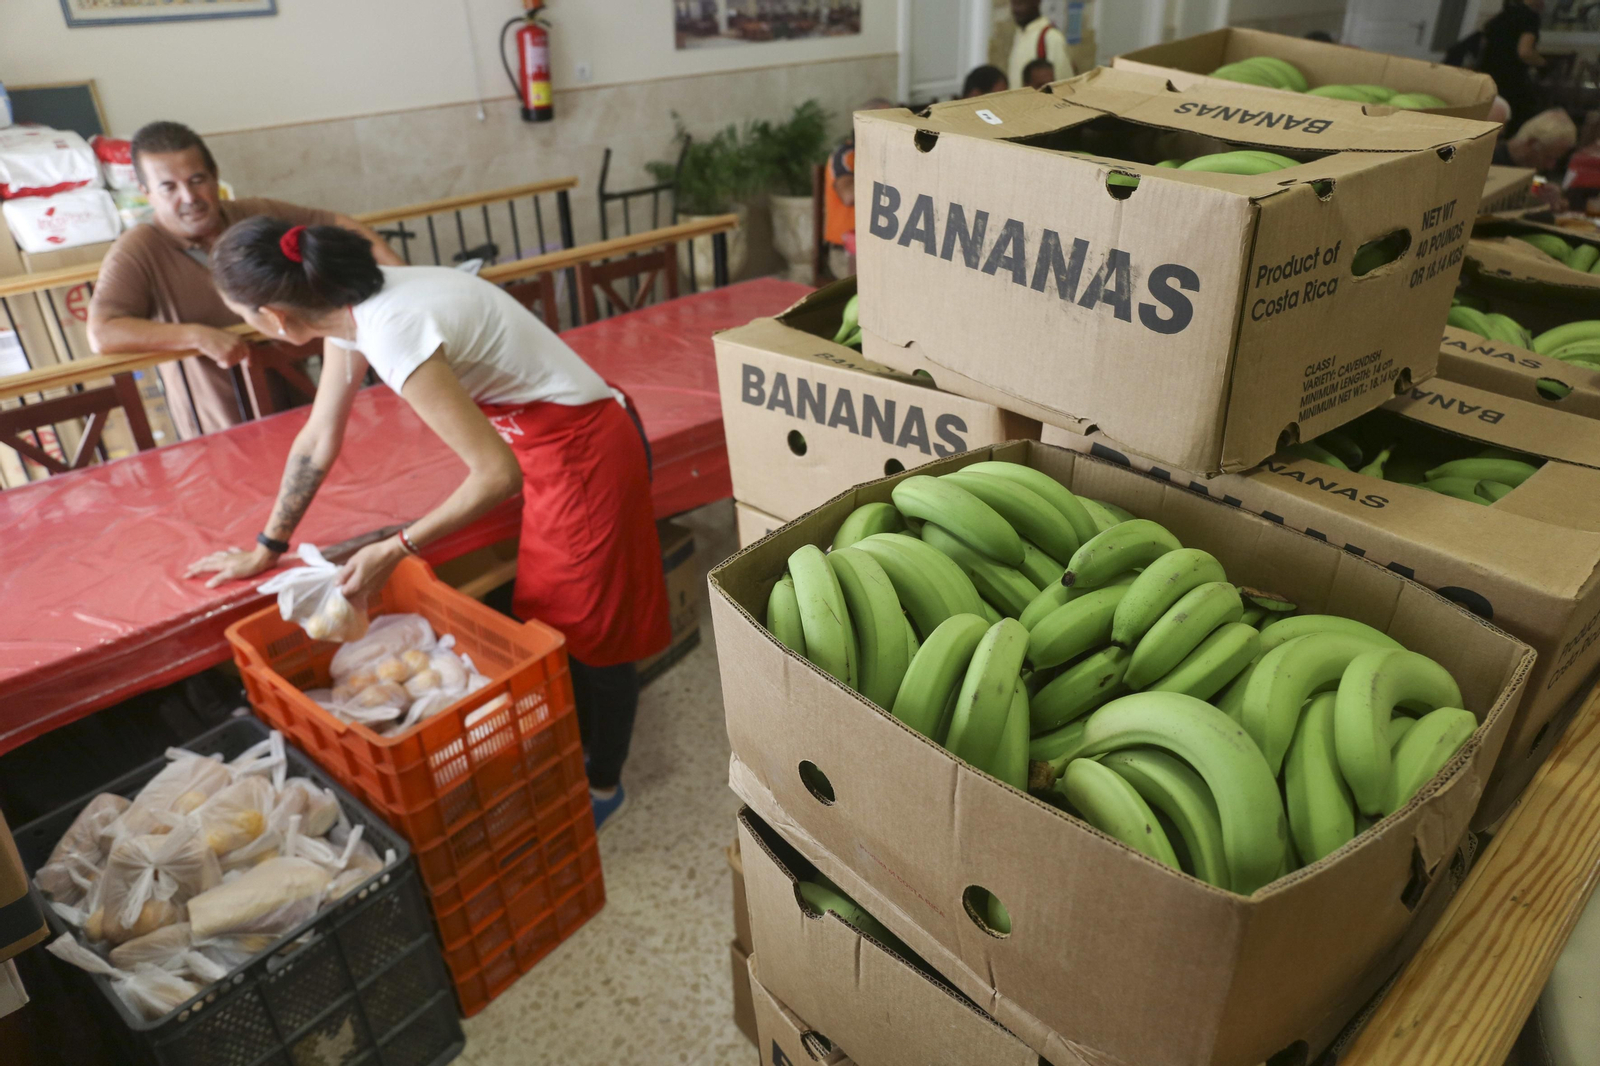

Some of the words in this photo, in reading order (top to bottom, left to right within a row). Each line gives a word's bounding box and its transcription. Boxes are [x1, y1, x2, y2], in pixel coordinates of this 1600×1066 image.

[1174, 102, 1333, 134] BANANAS
[1421, 207, 1443, 232] NET
[1443, 199, 1457, 220] WT
[869, 180, 1200, 335] BANANAS
[1416, 241, 1428, 260] 40
[1428, 221, 1465, 255] POUNDS
[1255, 247, 1320, 289] Product
[1322, 240, 1342, 266] of
[1409, 268, 1424, 289] OR
[1448, 245, 1465, 269] KGS
[1251, 288, 1300, 322] Costa
[1302, 277, 1339, 304] Rica
[1300, 382, 1339, 408] MINIMUM
[1340, 368, 1371, 390] LENGTH:
[1372, 362, 1382, 375] 14
[1382, 358, 1393, 370] cm
[1302, 369, 1336, 392] VARIETY:
[1338, 349, 1382, 377] CAVENDISH
[1304, 357, 1331, 377] CLASS
[742, 363, 968, 459] BANANAS
[1298, 396, 1337, 423] MINIMUM
[1338, 388, 1352, 405] NET
